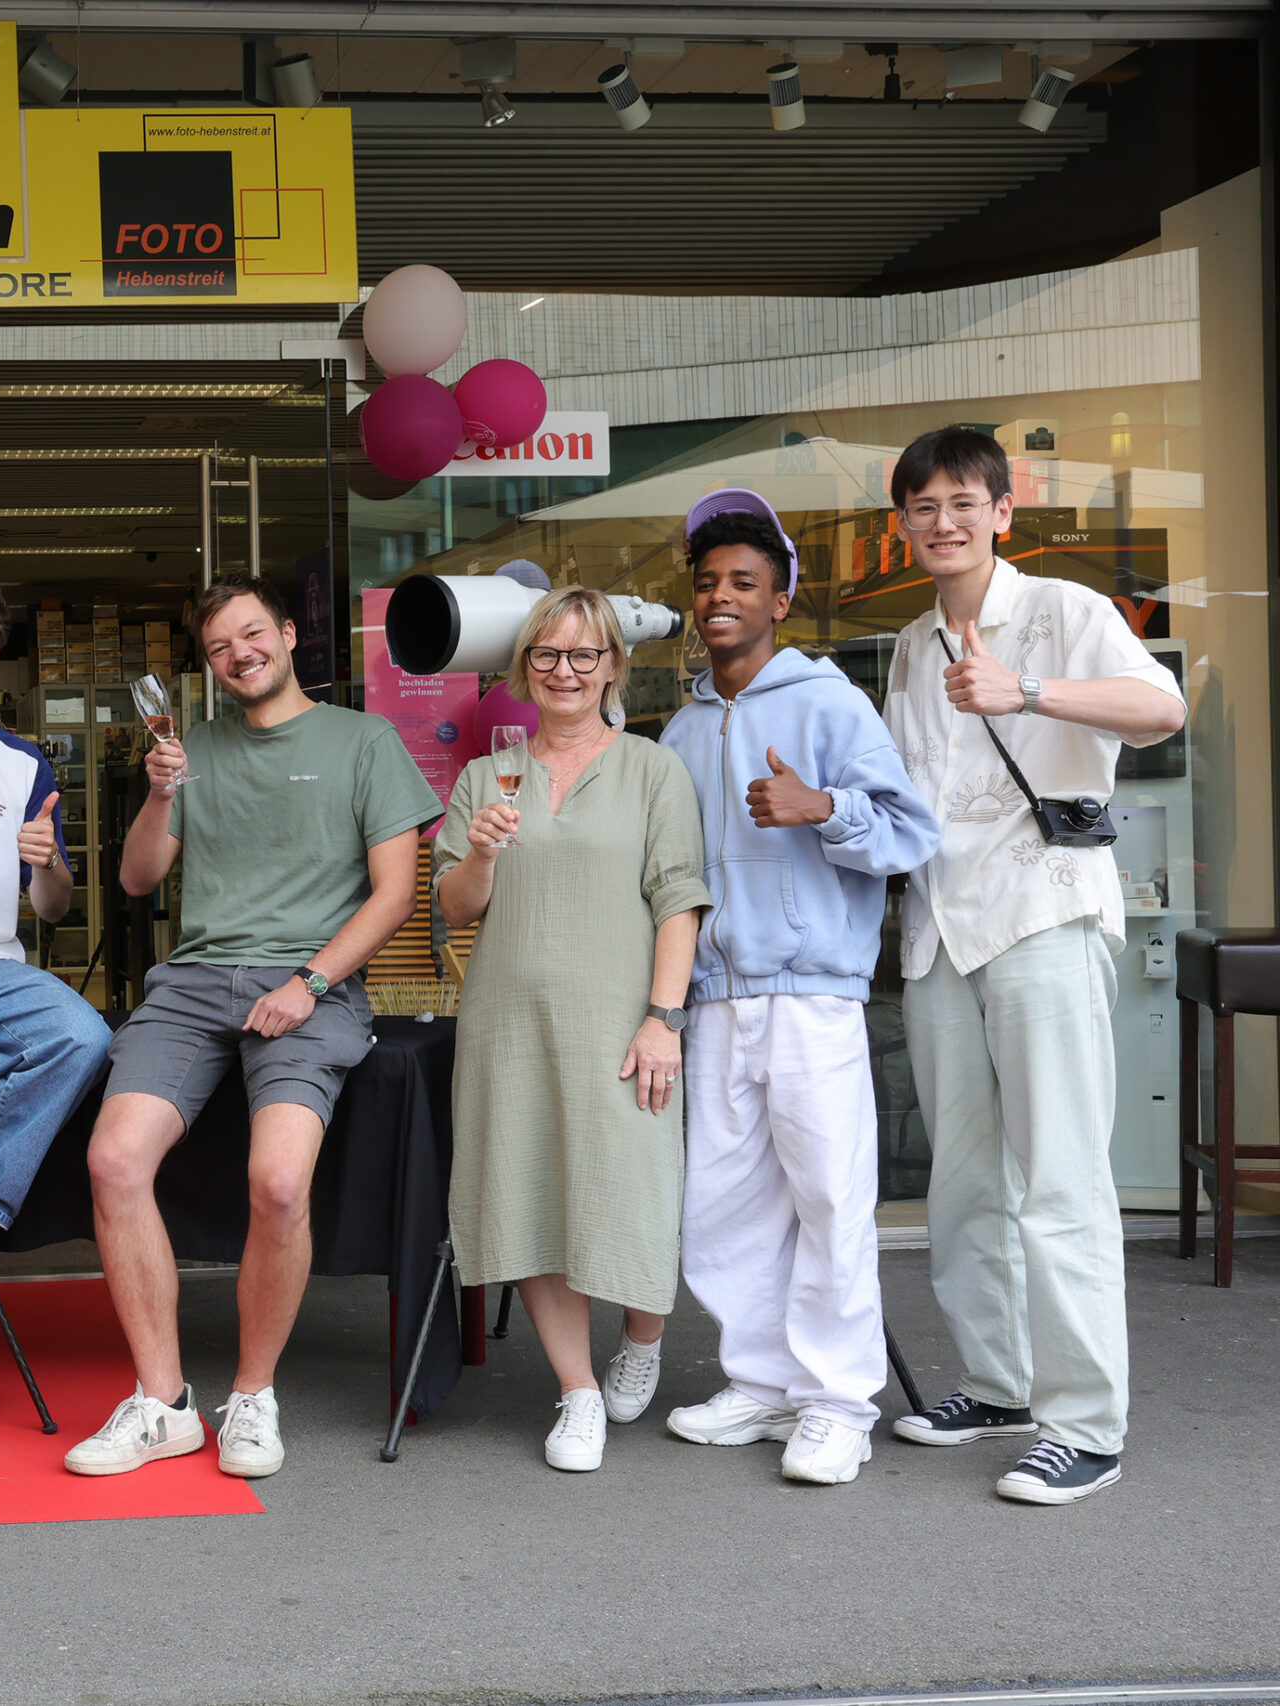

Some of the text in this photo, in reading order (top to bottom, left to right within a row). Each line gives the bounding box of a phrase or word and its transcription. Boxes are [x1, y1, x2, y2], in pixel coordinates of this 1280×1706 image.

[148, 125, 273, 139] www.foto-hebenstreit.at
[115, 223, 224, 255] FOTO
[116, 268, 226, 288] Hebenstreit
[452, 432, 593, 461] anon
[1052, 534, 1090, 542] SONY
[398, 679, 444, 687] hochladen
[400, 688, 443, 698] gewinnen
